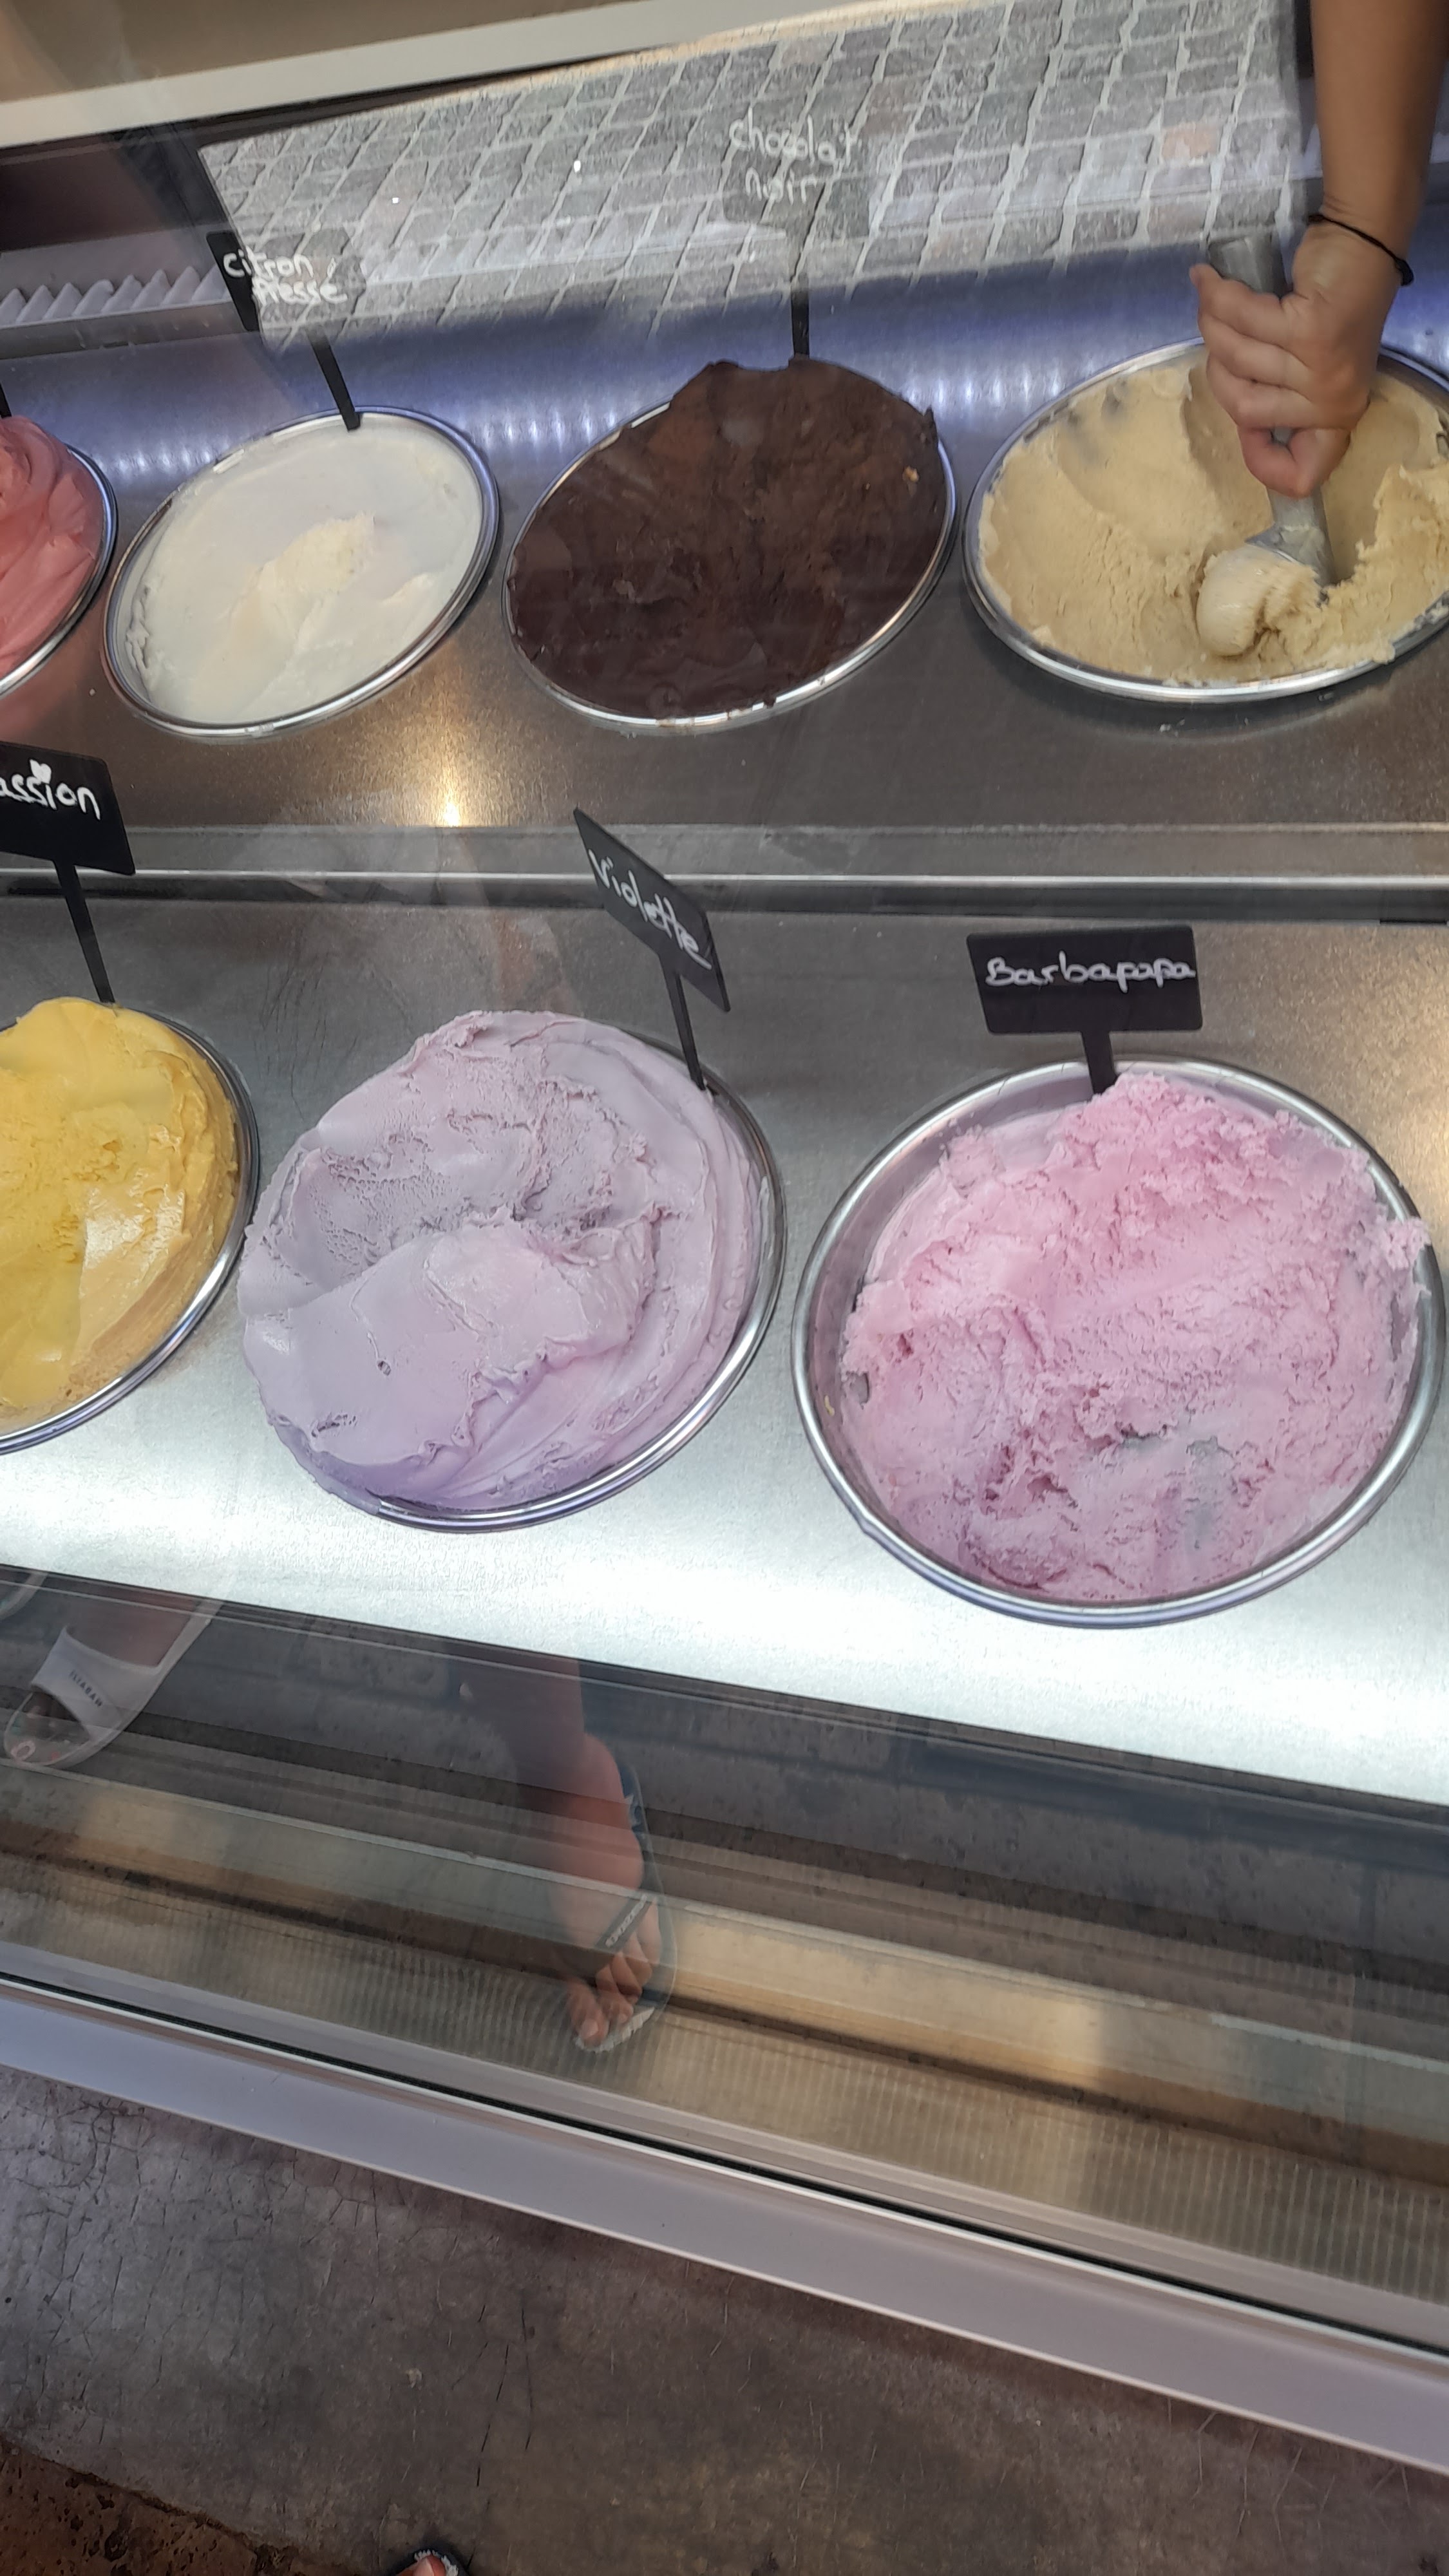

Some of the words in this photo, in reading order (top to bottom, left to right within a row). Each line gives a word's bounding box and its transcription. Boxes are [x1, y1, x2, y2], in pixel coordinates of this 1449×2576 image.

[223, 245, 314, 278] Citron
[588, 848, 712, 971] Violette
[985, 950, 1196, 993] Barbapapa
